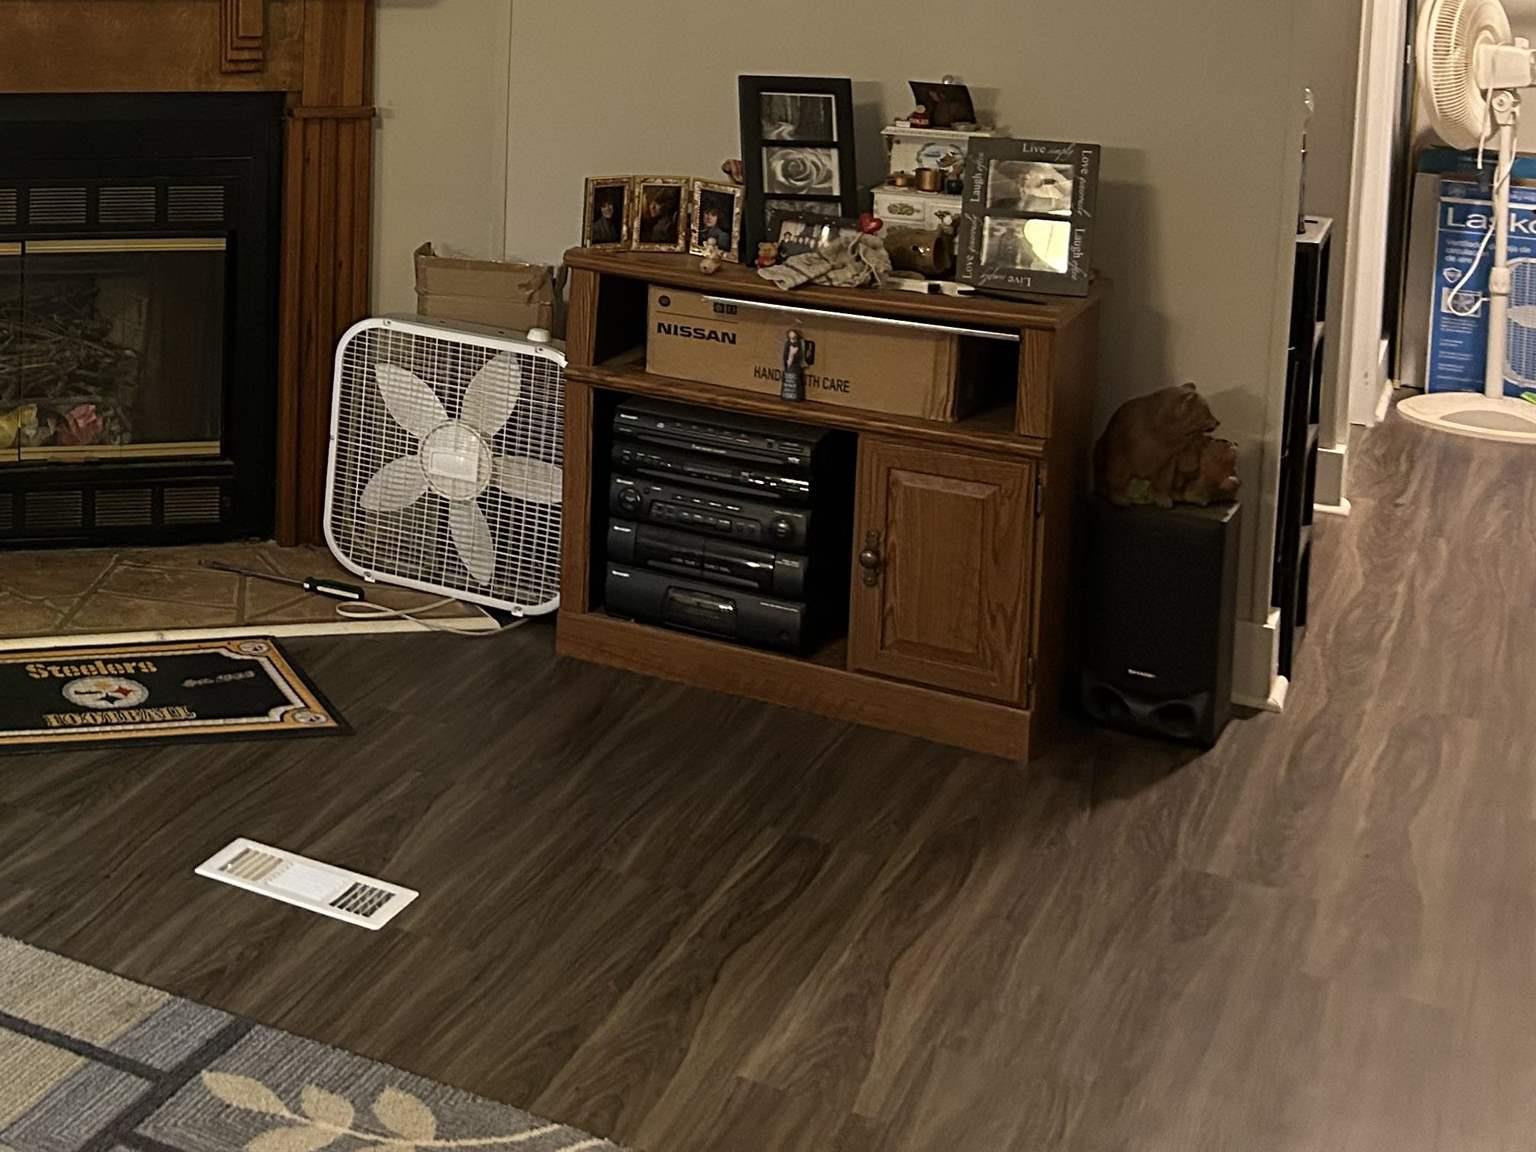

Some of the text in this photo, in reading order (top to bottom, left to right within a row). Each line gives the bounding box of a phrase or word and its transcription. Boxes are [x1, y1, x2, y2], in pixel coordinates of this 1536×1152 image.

[1022, 143, 1046, 154] Live
[1080, 150, 1093, 174] Love
[970, 172, 984, 203] Laugh
[1446, 207, 1536, 235] Lak
[1071, 228, 1086, 259] Laugh
[657, 322, 737, 345] NISSAN
[753, 365, 782, 382] HAND
[822, 376, 851, 393] CARE
[26, 660, 157, 679] Steelers
